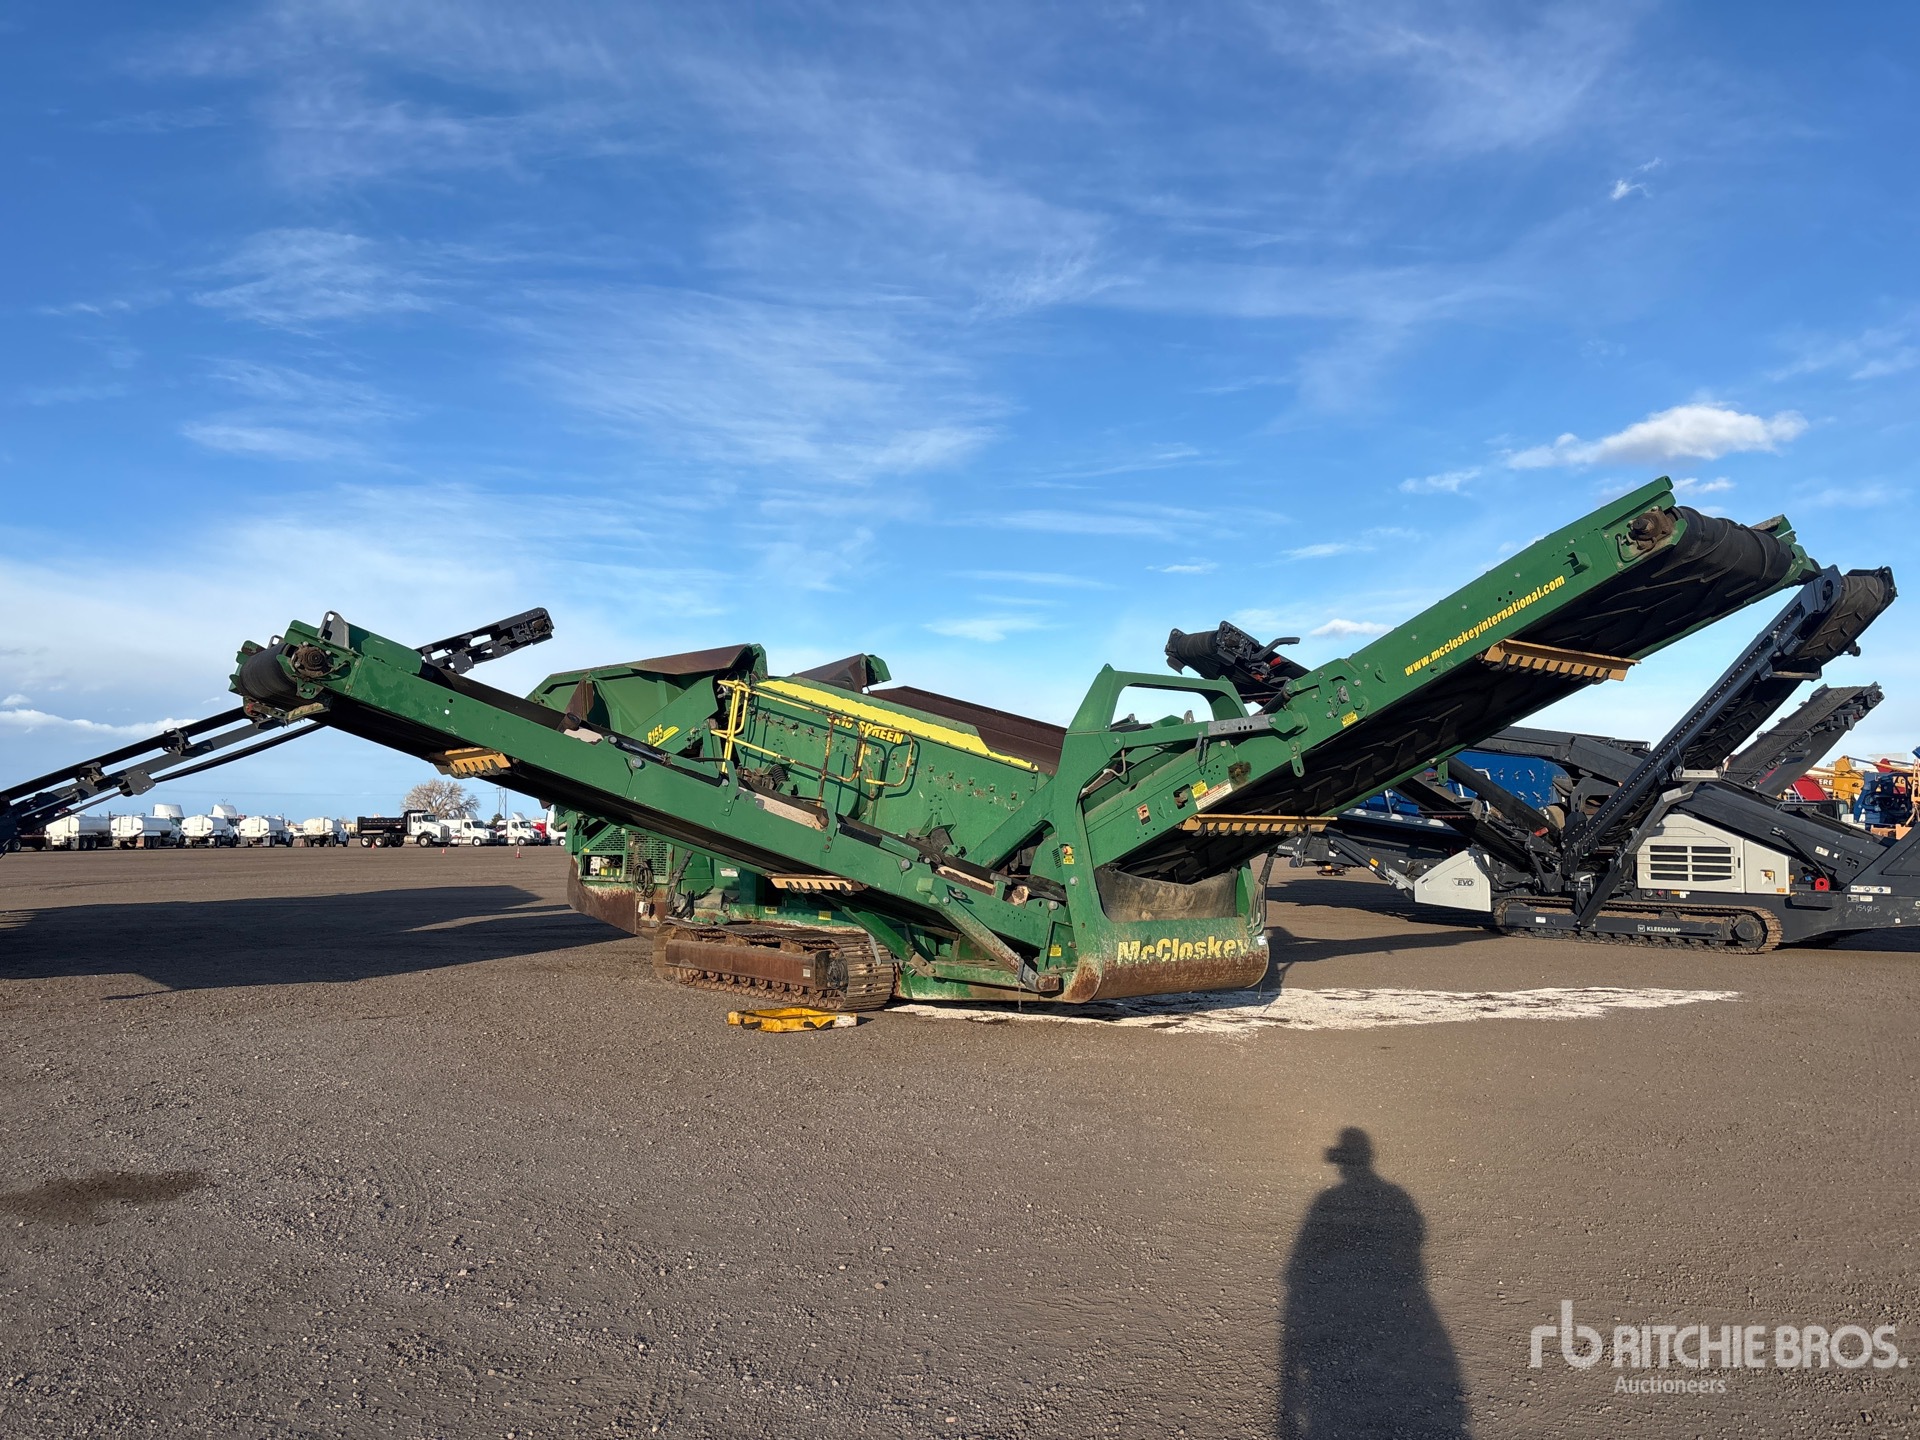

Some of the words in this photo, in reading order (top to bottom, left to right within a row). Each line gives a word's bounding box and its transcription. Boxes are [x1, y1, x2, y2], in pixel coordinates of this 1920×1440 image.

[1404, 575, 1565, 677] www.mccloskeyinternational.com
[1818, 778, 1833, 786] ERE
[1457, 879, 1474, 887] EVO
[1646, 925, 1681, 933] KLEEMANN
[1117, 936, 1250, 966] McCloskey
